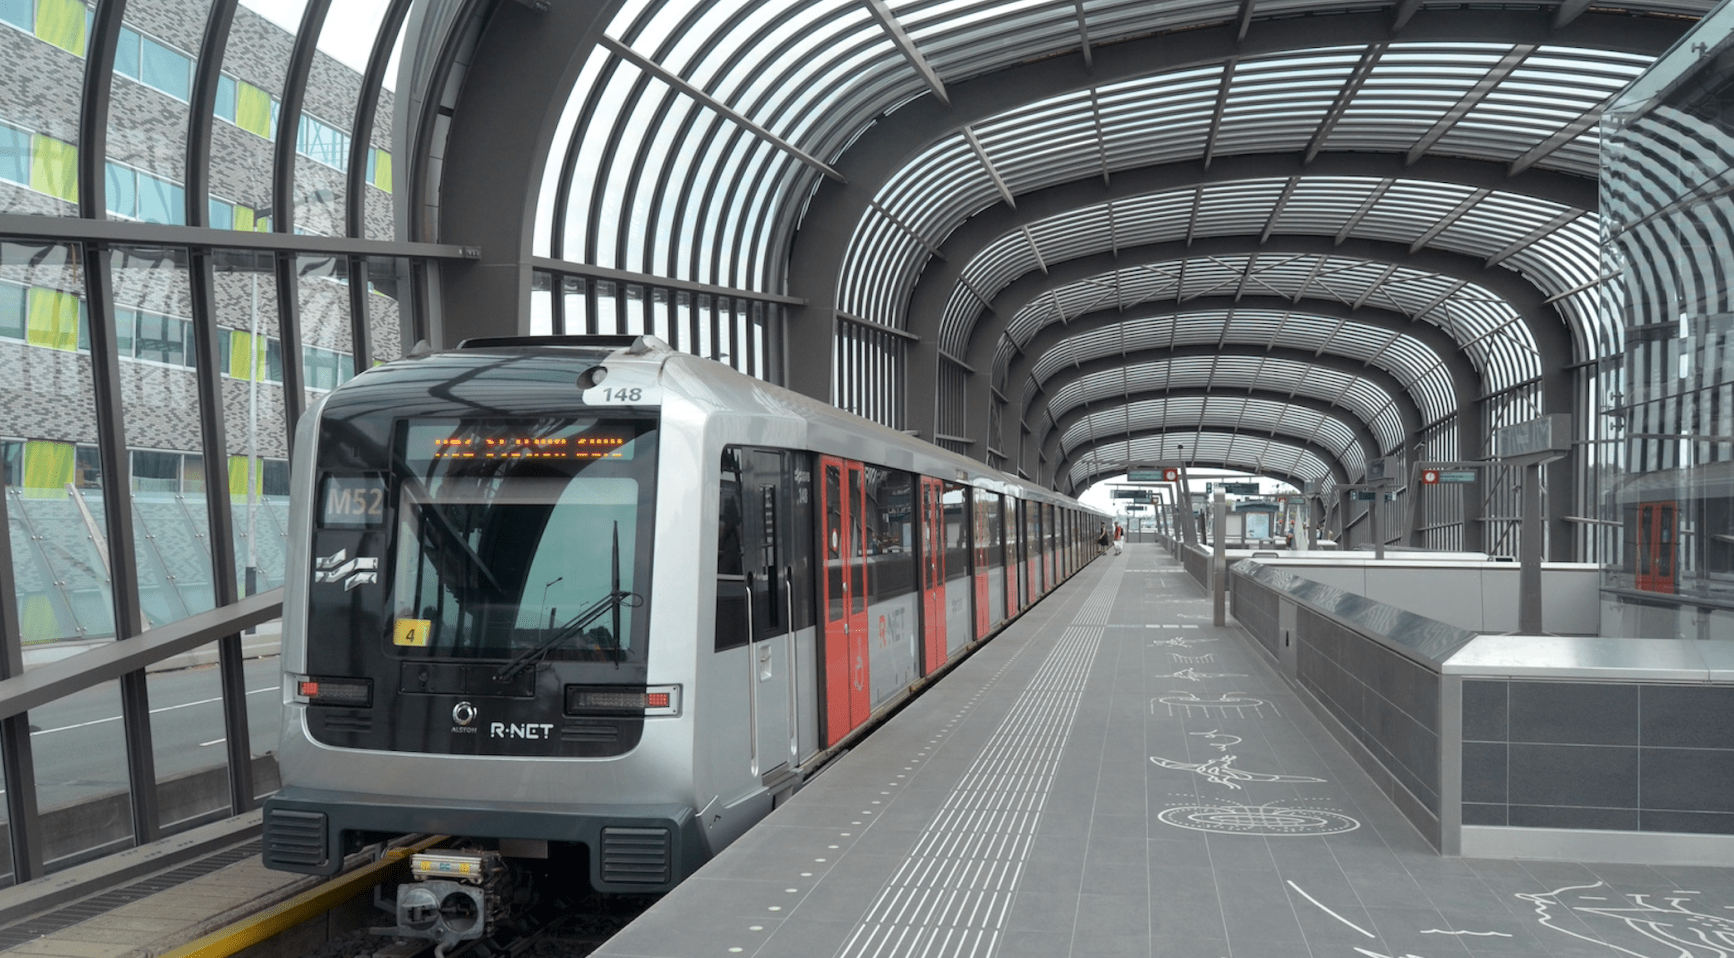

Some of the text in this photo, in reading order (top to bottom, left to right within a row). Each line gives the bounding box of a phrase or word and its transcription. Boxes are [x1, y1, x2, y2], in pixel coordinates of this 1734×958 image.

[603, 387, 643, 402] 148
[328, 488, 383, 515] M52
[405, 628, 415, 643] 4
